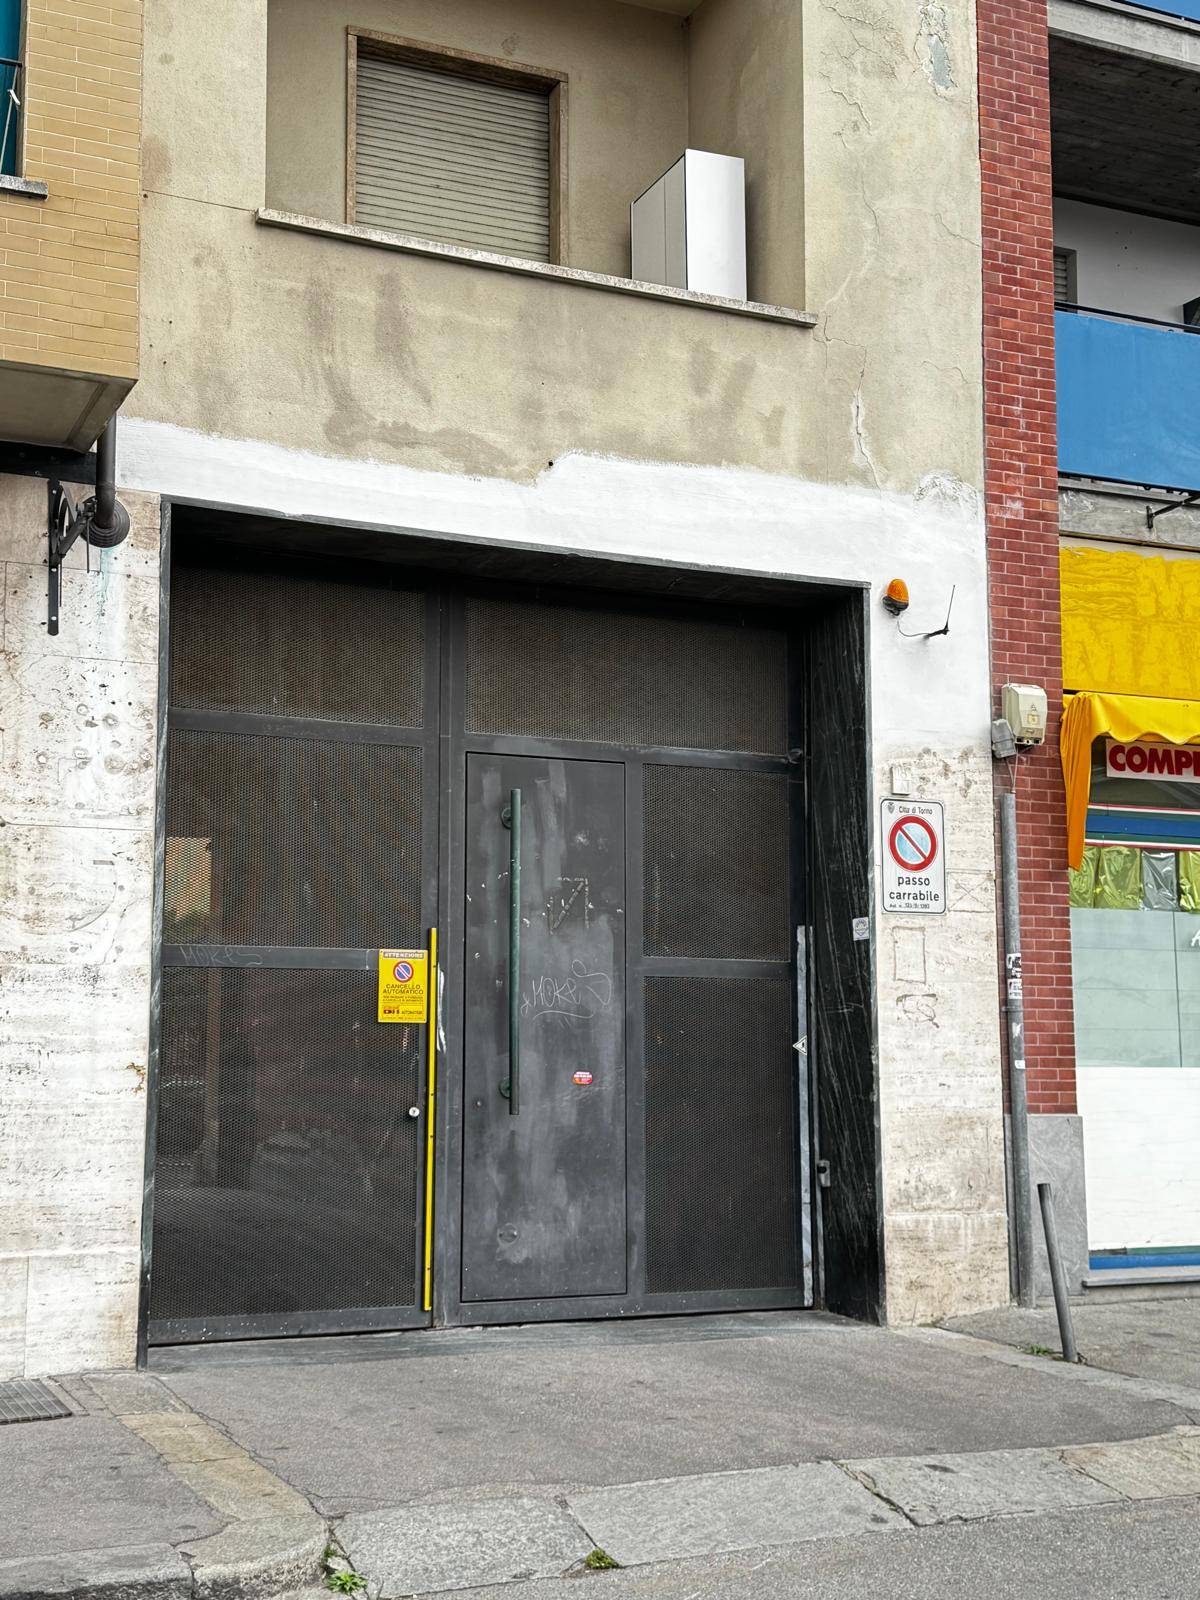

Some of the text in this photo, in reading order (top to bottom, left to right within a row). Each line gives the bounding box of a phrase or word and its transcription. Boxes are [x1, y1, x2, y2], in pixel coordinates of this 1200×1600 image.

[917, 806, 933, 815] Torino
[897, 876, 931, 886] passo
[889, 889, 940, 902] carrabile
